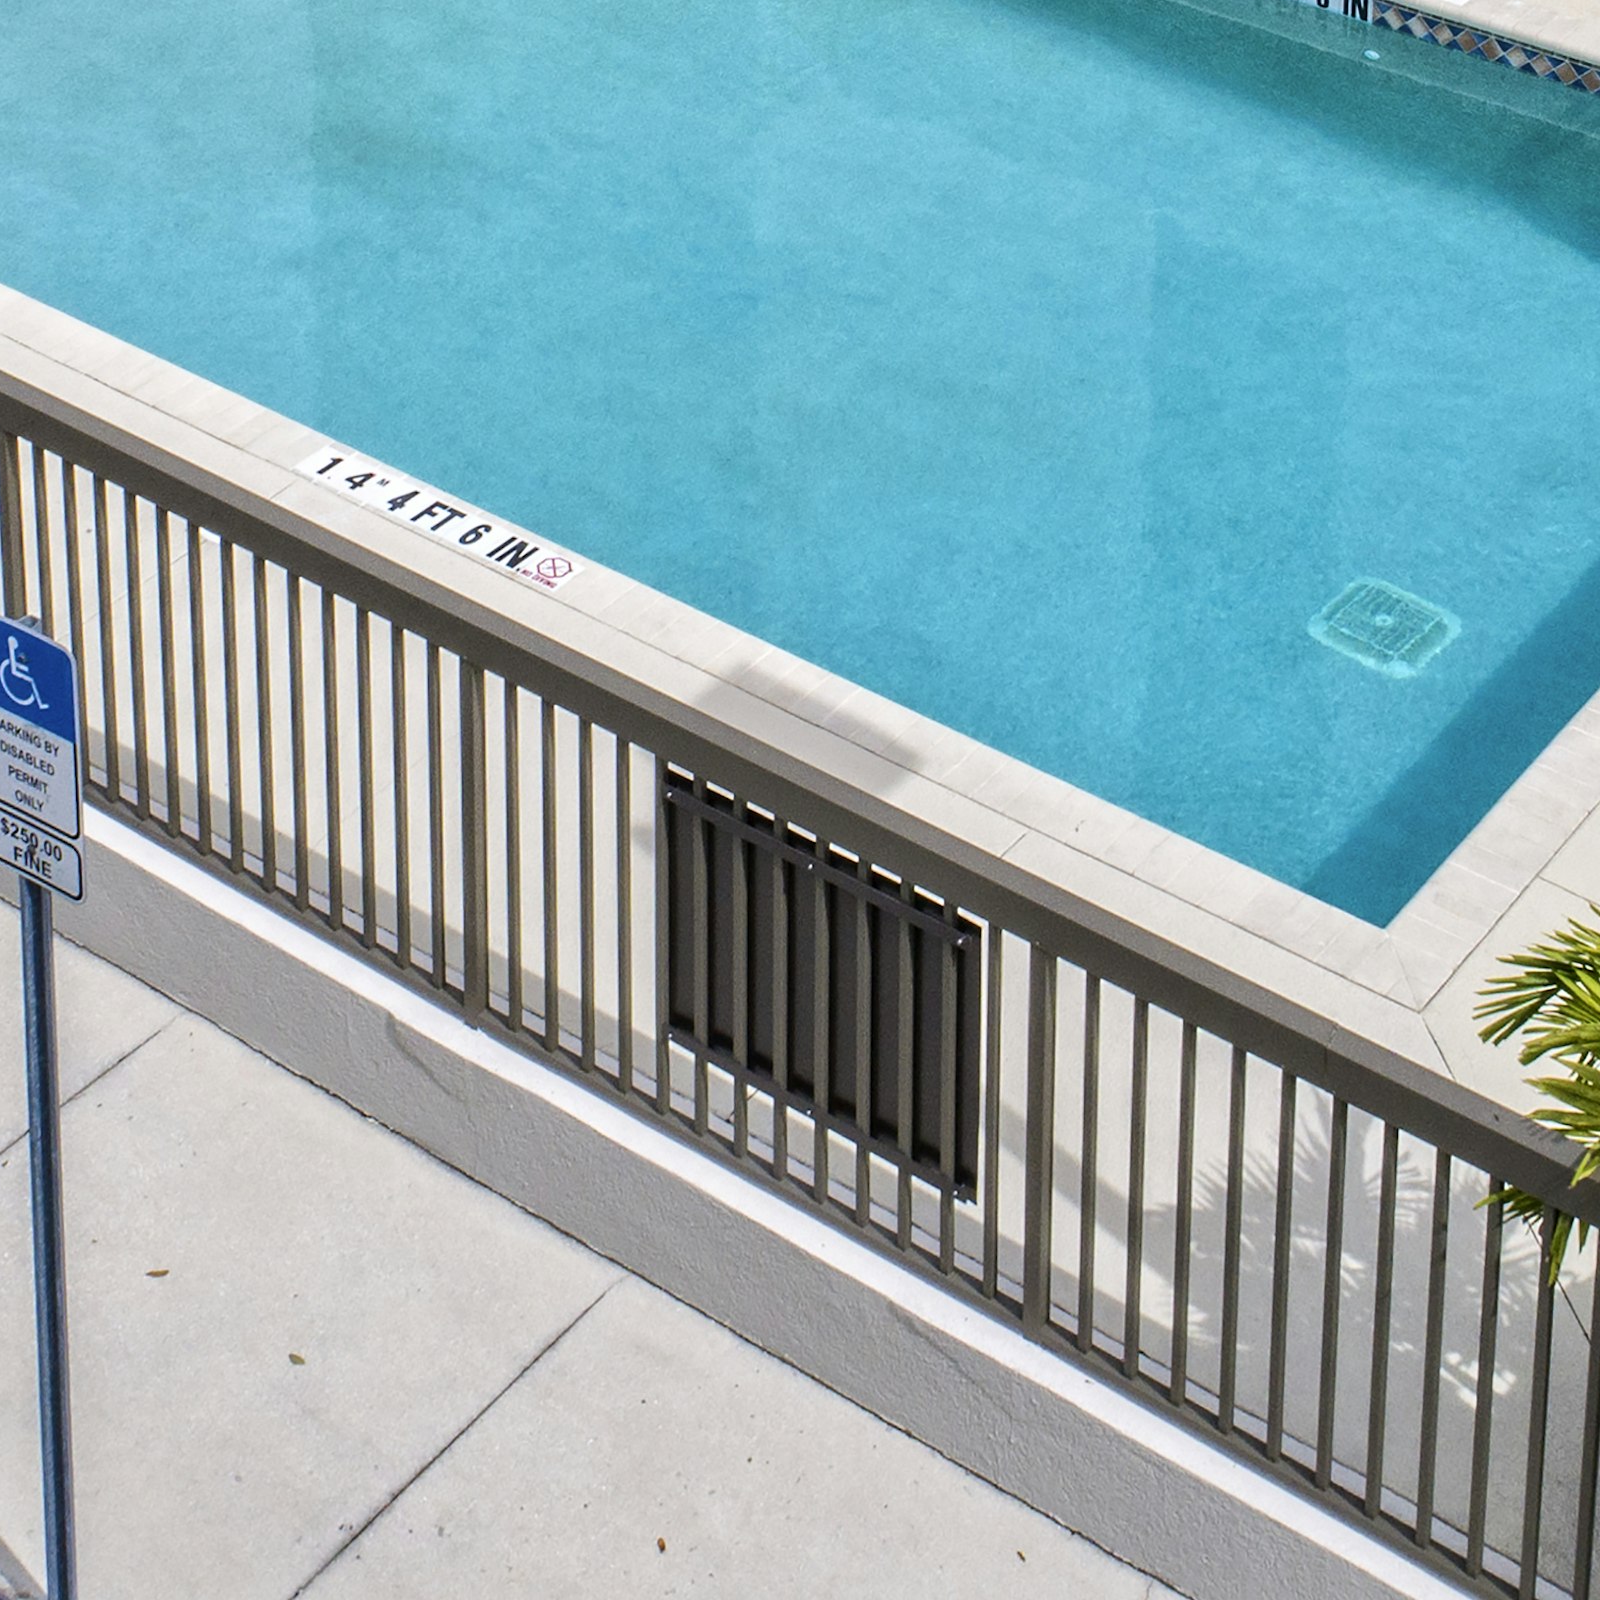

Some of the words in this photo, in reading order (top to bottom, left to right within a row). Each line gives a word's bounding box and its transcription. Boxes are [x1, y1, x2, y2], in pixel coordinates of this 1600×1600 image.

[386, 490, 420, 512] 4
[409, 500, 467, 531] FT
[458, 523, 492, 545] 6
[0, 740, 55, 777] DISABLED
[43, 739, 60, 758] BY
[8, 764, 48, 795] PERMIT
[15, 789, 45, 813] ONLY
[0, 816, 63, 863] $250.00
[13, 846, 52, 879] FINE
